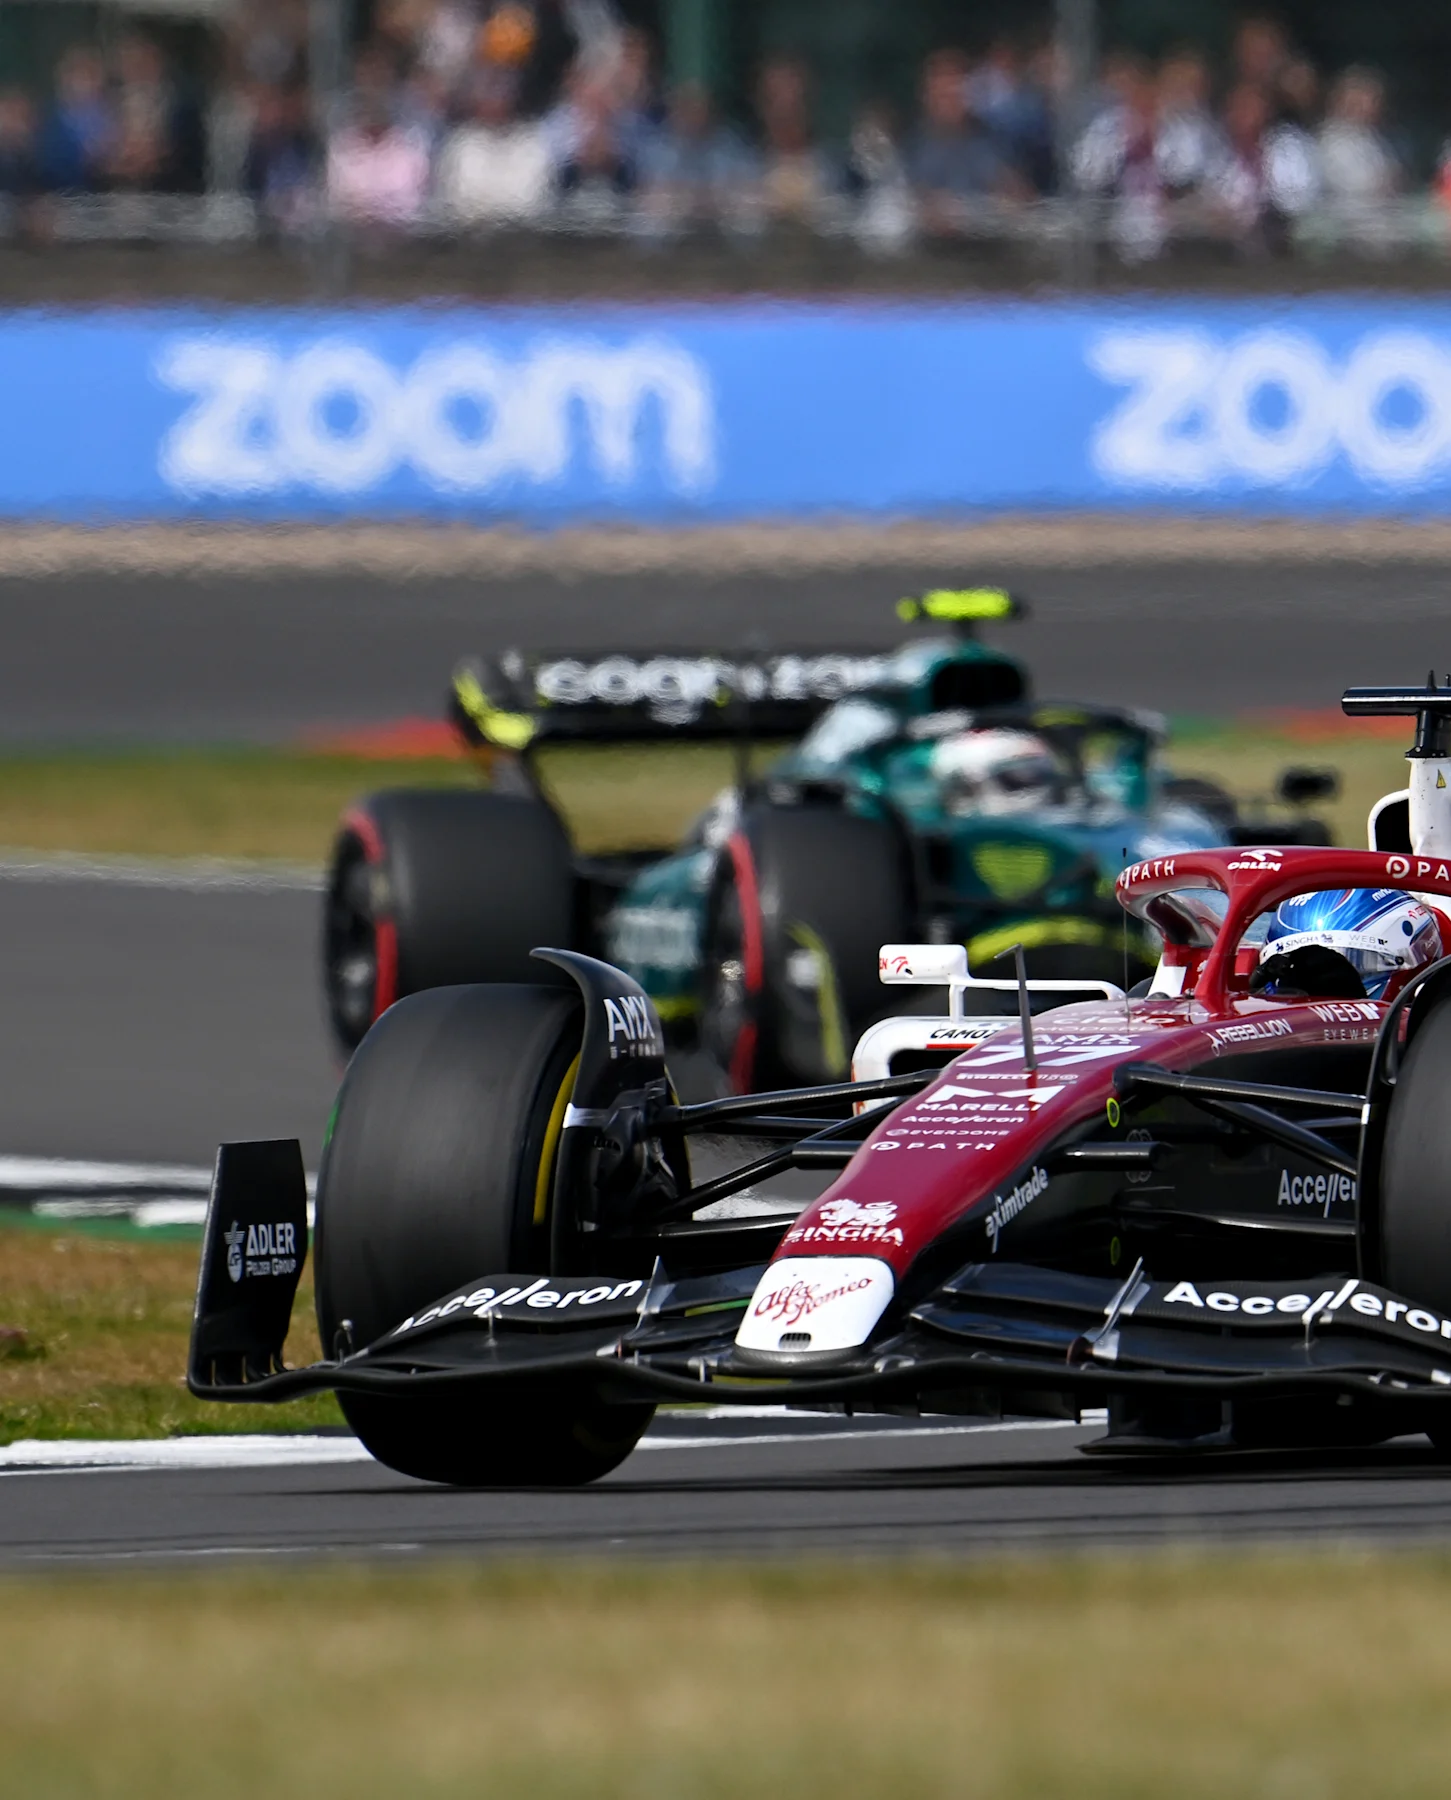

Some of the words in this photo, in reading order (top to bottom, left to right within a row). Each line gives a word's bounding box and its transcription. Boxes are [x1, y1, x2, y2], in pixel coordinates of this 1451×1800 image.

[155, 333, 716, 496] zoom
[1131, 859, 1175, 883] PATH
[1227, 861, 1282, 872] ORLEN
[604, 996, 656, 1042] AMX
[1308, 1003, 1362, 1022] WEB
[956, 1045, 1141, 1067] 77
[915, 1103, 1042, 1111] MARELLI
[906, 1142, 996, 1151] PATH
[246, 1222, 296, 1257] ADLER
[786, 1226, 904, 1241] SINGHA
